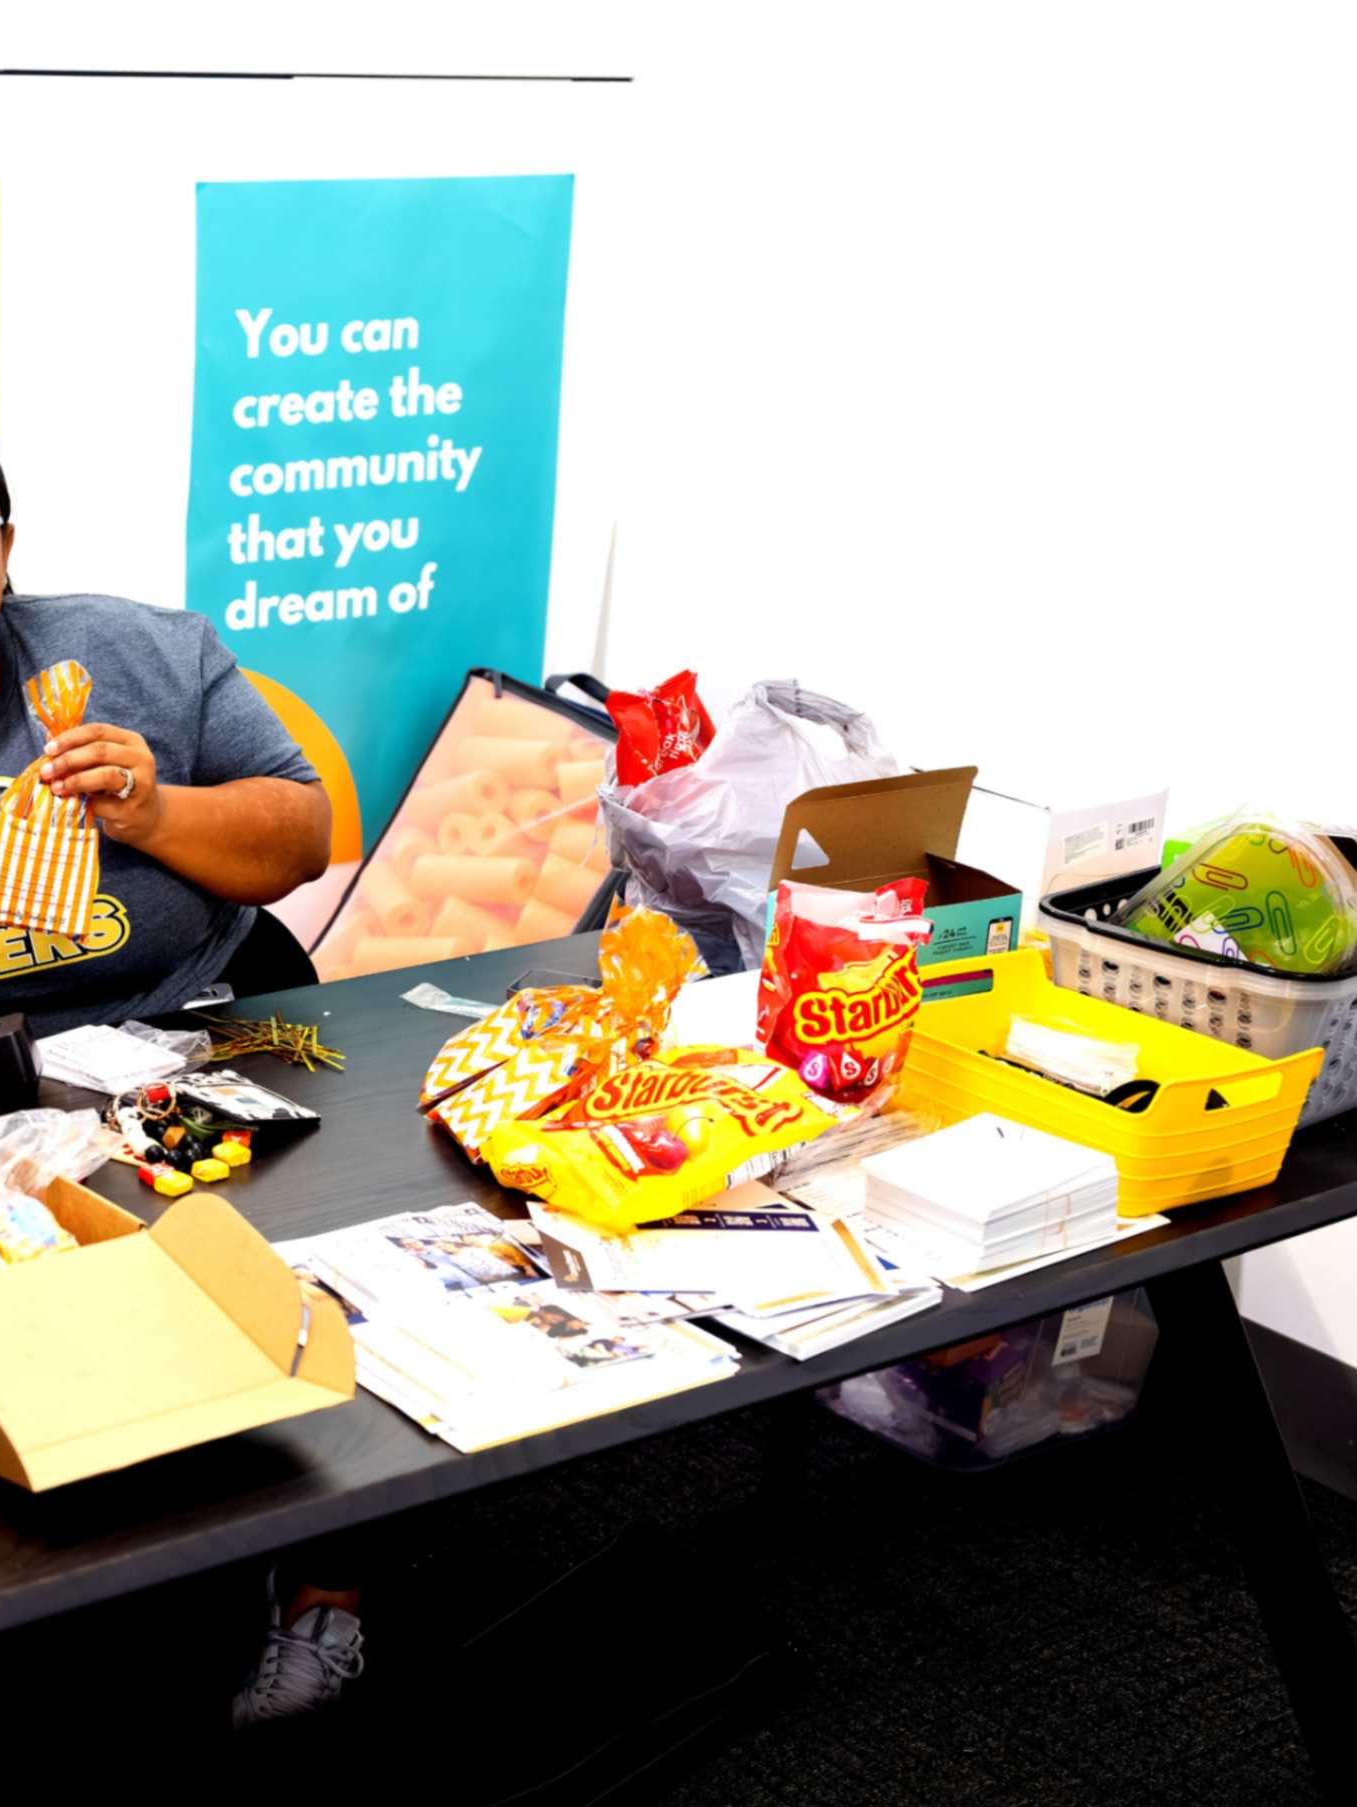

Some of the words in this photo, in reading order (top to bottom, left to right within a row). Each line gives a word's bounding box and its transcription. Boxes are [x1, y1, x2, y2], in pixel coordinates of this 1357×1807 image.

[235, 308, 329, 358] You
[341, 317, 419, 353] can
[233, 379, 379, 429] create
[389, 366, 463, 417] the
[229, 434, 483, 497] community
[228, 513, 325, 565] that
[334, 517, 419, 567] you
[225, 580, 378, 631] dream
[388, 562, 437, 613] of
